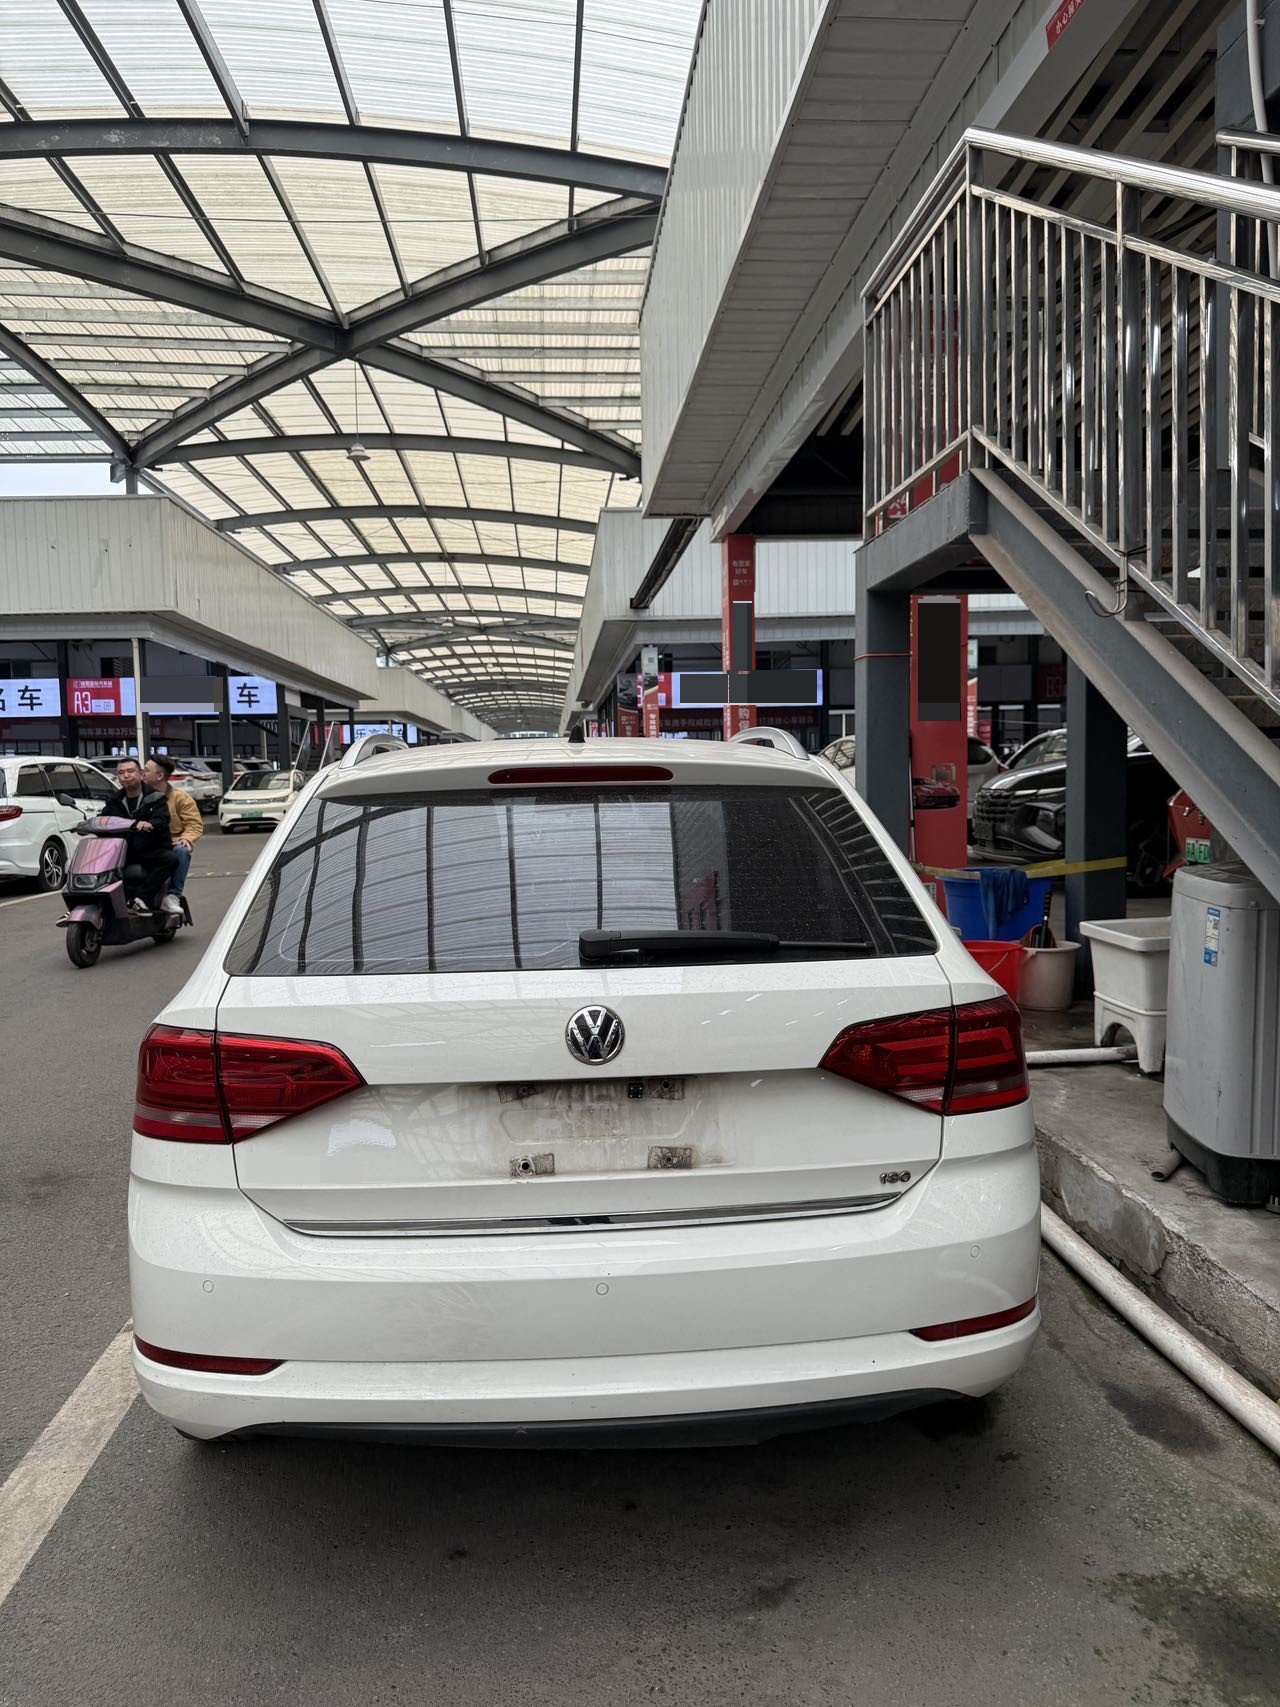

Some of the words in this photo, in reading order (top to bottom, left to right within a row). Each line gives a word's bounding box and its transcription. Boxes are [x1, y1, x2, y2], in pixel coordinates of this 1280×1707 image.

[74, 691, 91, 713] A3
[236, 682, 261, 708] 车
[565, 1004, 626, 1066] VW
